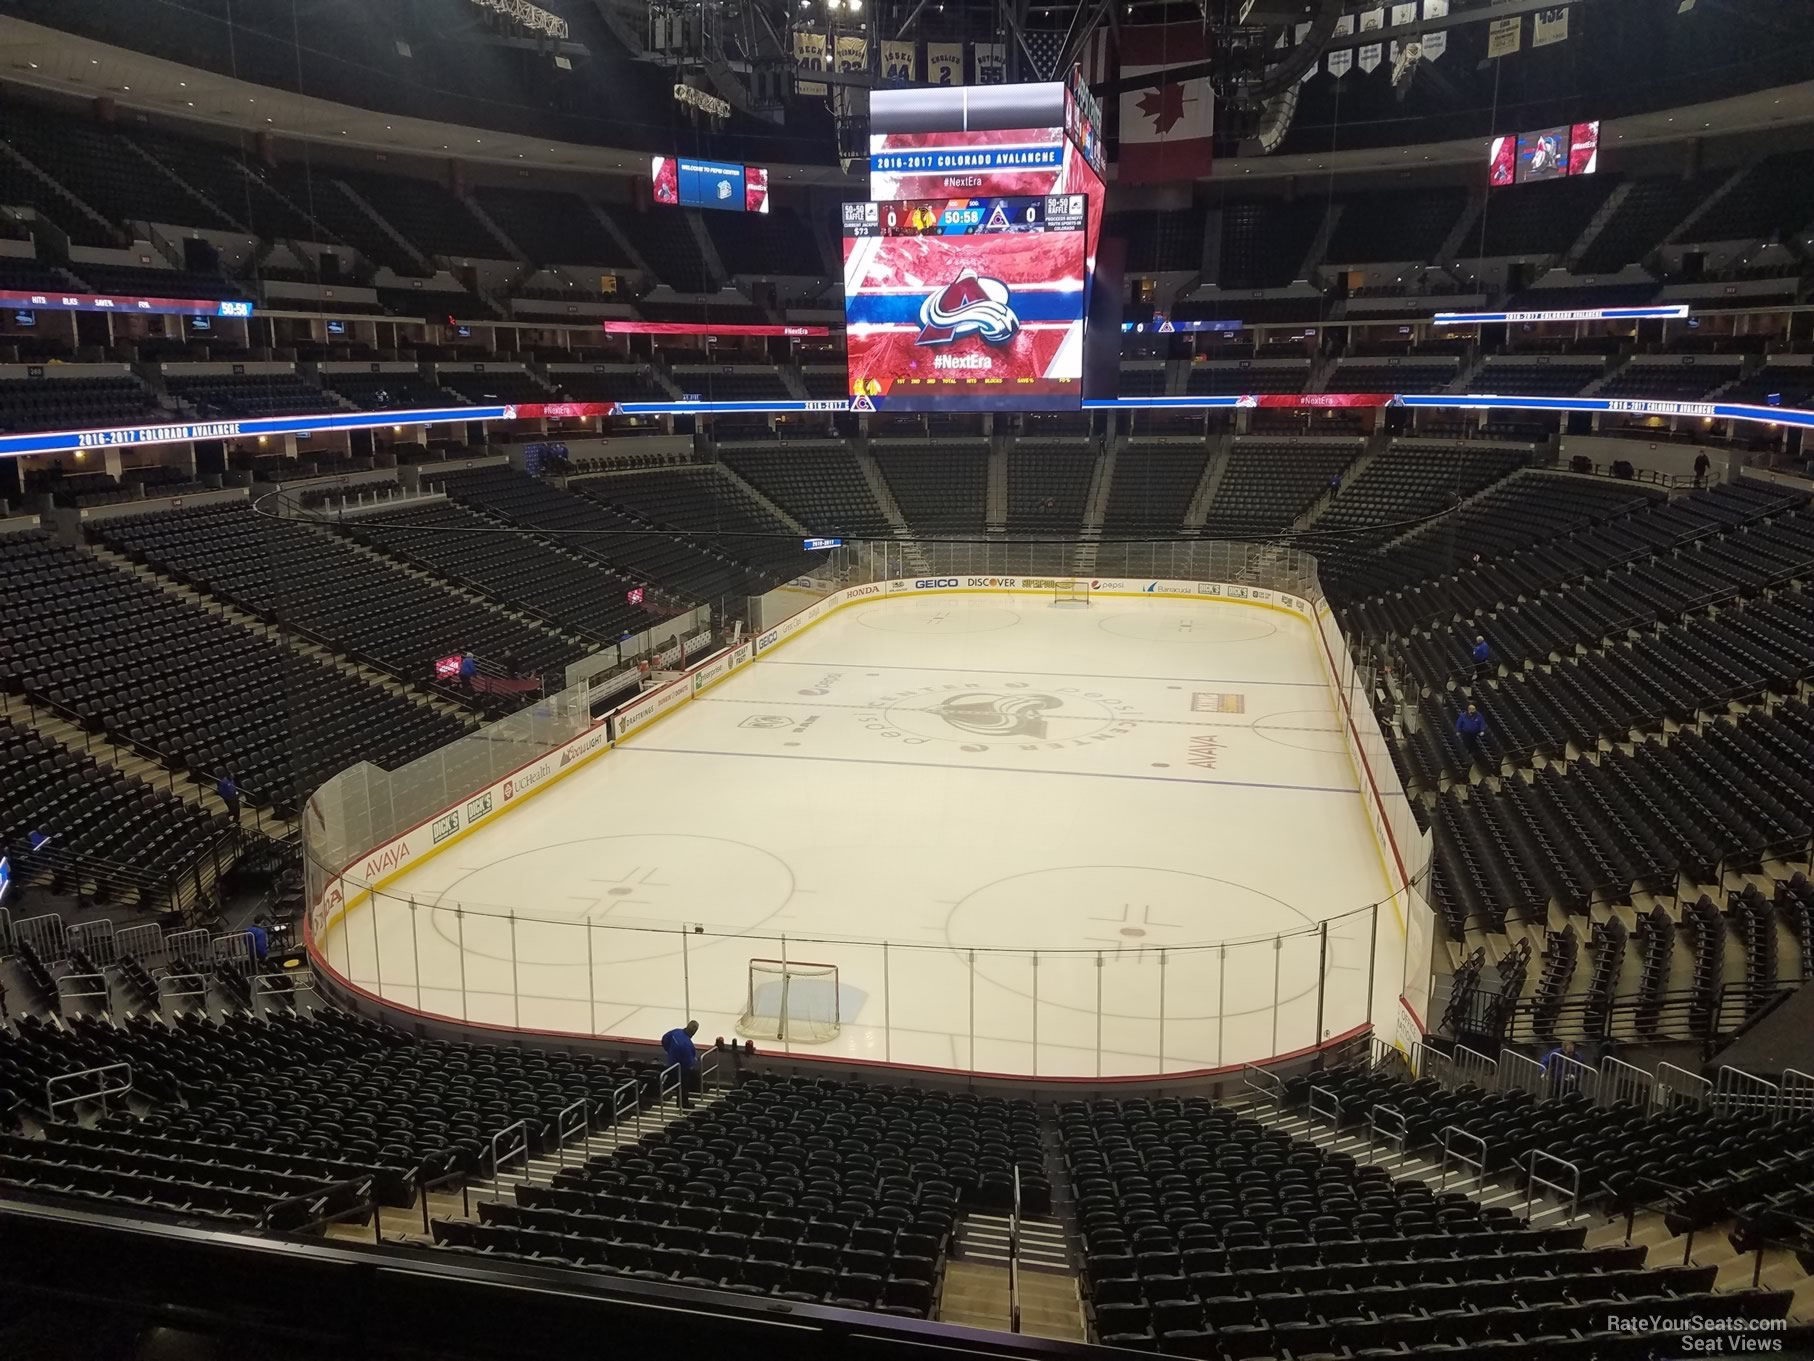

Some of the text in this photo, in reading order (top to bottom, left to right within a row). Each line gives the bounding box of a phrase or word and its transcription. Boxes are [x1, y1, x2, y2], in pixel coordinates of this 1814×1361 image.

[877, 151, 1055, 169] 2016-2017 COLORADO AVALANCHE
[943, 176, 982, 187] #NextEra
[1026, 207, 1036, 222] 0
[1048, 206, 1067, 214] RAFFLE
[887, 211, 897, 227] 0
[854, 228, 868, 236] $73
[934, 354, 992, 369] #NextEra
[78, 423, 240, 447] 2016-2017 COLORADO AVALANCHE
[915, 578, 959, 589] GEICO
[967, 578, 1015, 588] DISCOVER
[1102, 581, 1124, 589] pepsi
[846, 585, 880, 599] HONDA
[759, 630, 778, 650] GEICO
[626, 705, 654, 727] DRAFTKINGS
[1187, 735, 1227, 770] AVAYA
[514, 763, 551, 793] UCHealth
[365, 841, 411, 881] AVAYA
